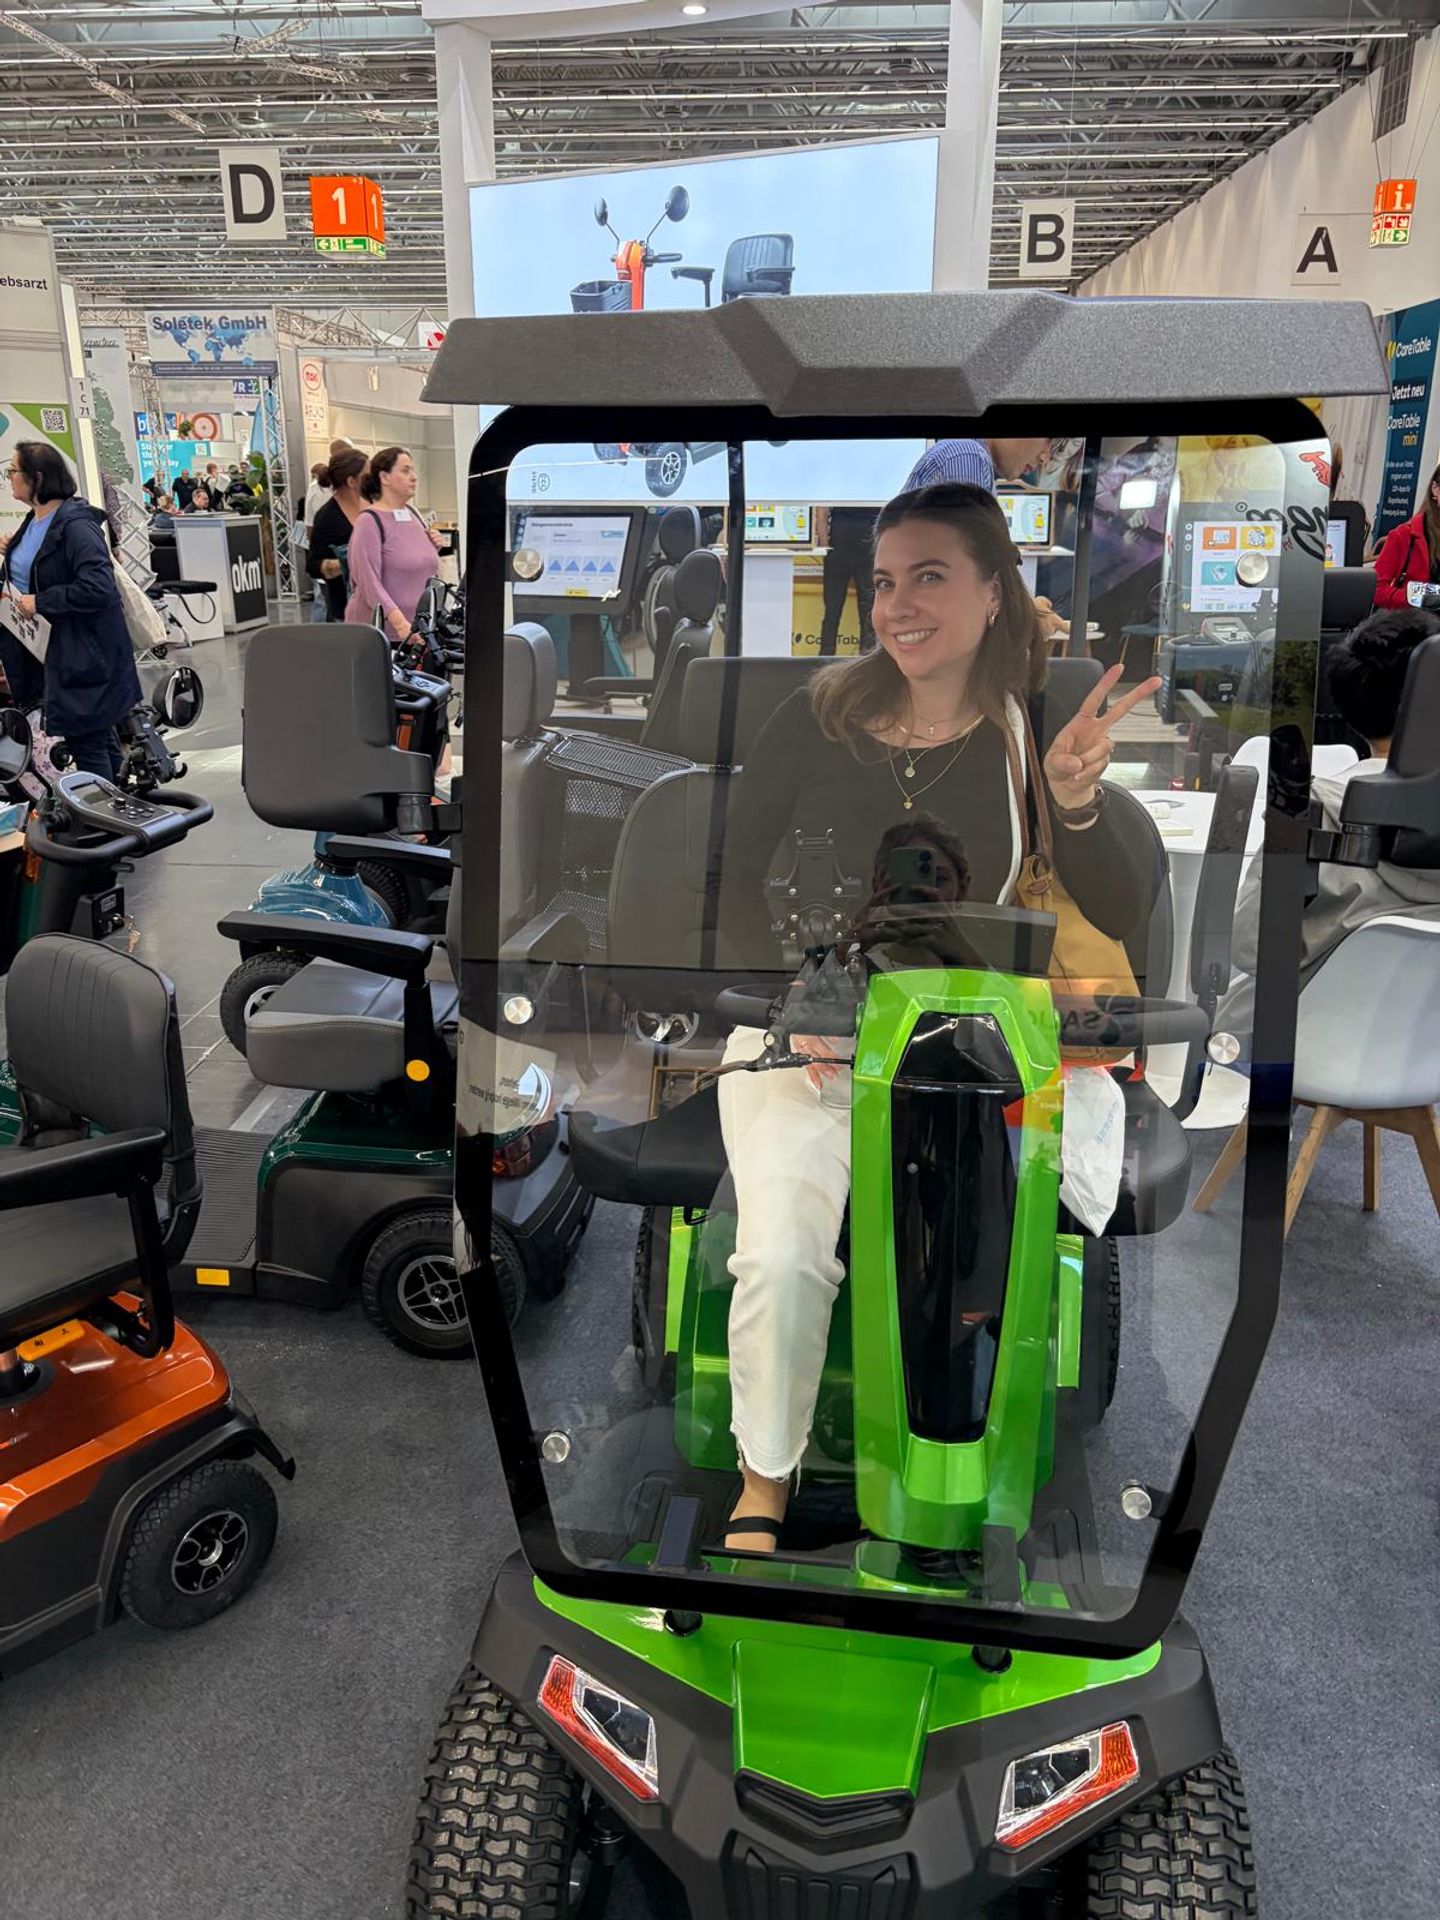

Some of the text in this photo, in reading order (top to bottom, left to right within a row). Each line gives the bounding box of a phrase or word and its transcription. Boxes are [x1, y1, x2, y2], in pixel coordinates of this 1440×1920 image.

[229, 164, 275, 224] D
[331, 187, 347, 225] 1
[1027, 213, 1066, 264] B
[1296, 226, 1338, 273] A
[152, 316, 267, 331] Soletek GmbH
[1396, 336, 1431, 358] CareTable
[1392, 384, 1426, 401] Jetzt neu
[1388, 413, 1421, 430] CareTable
[1403, 431, 1419, 446] mini
[232, 554, 262, 594] okm
